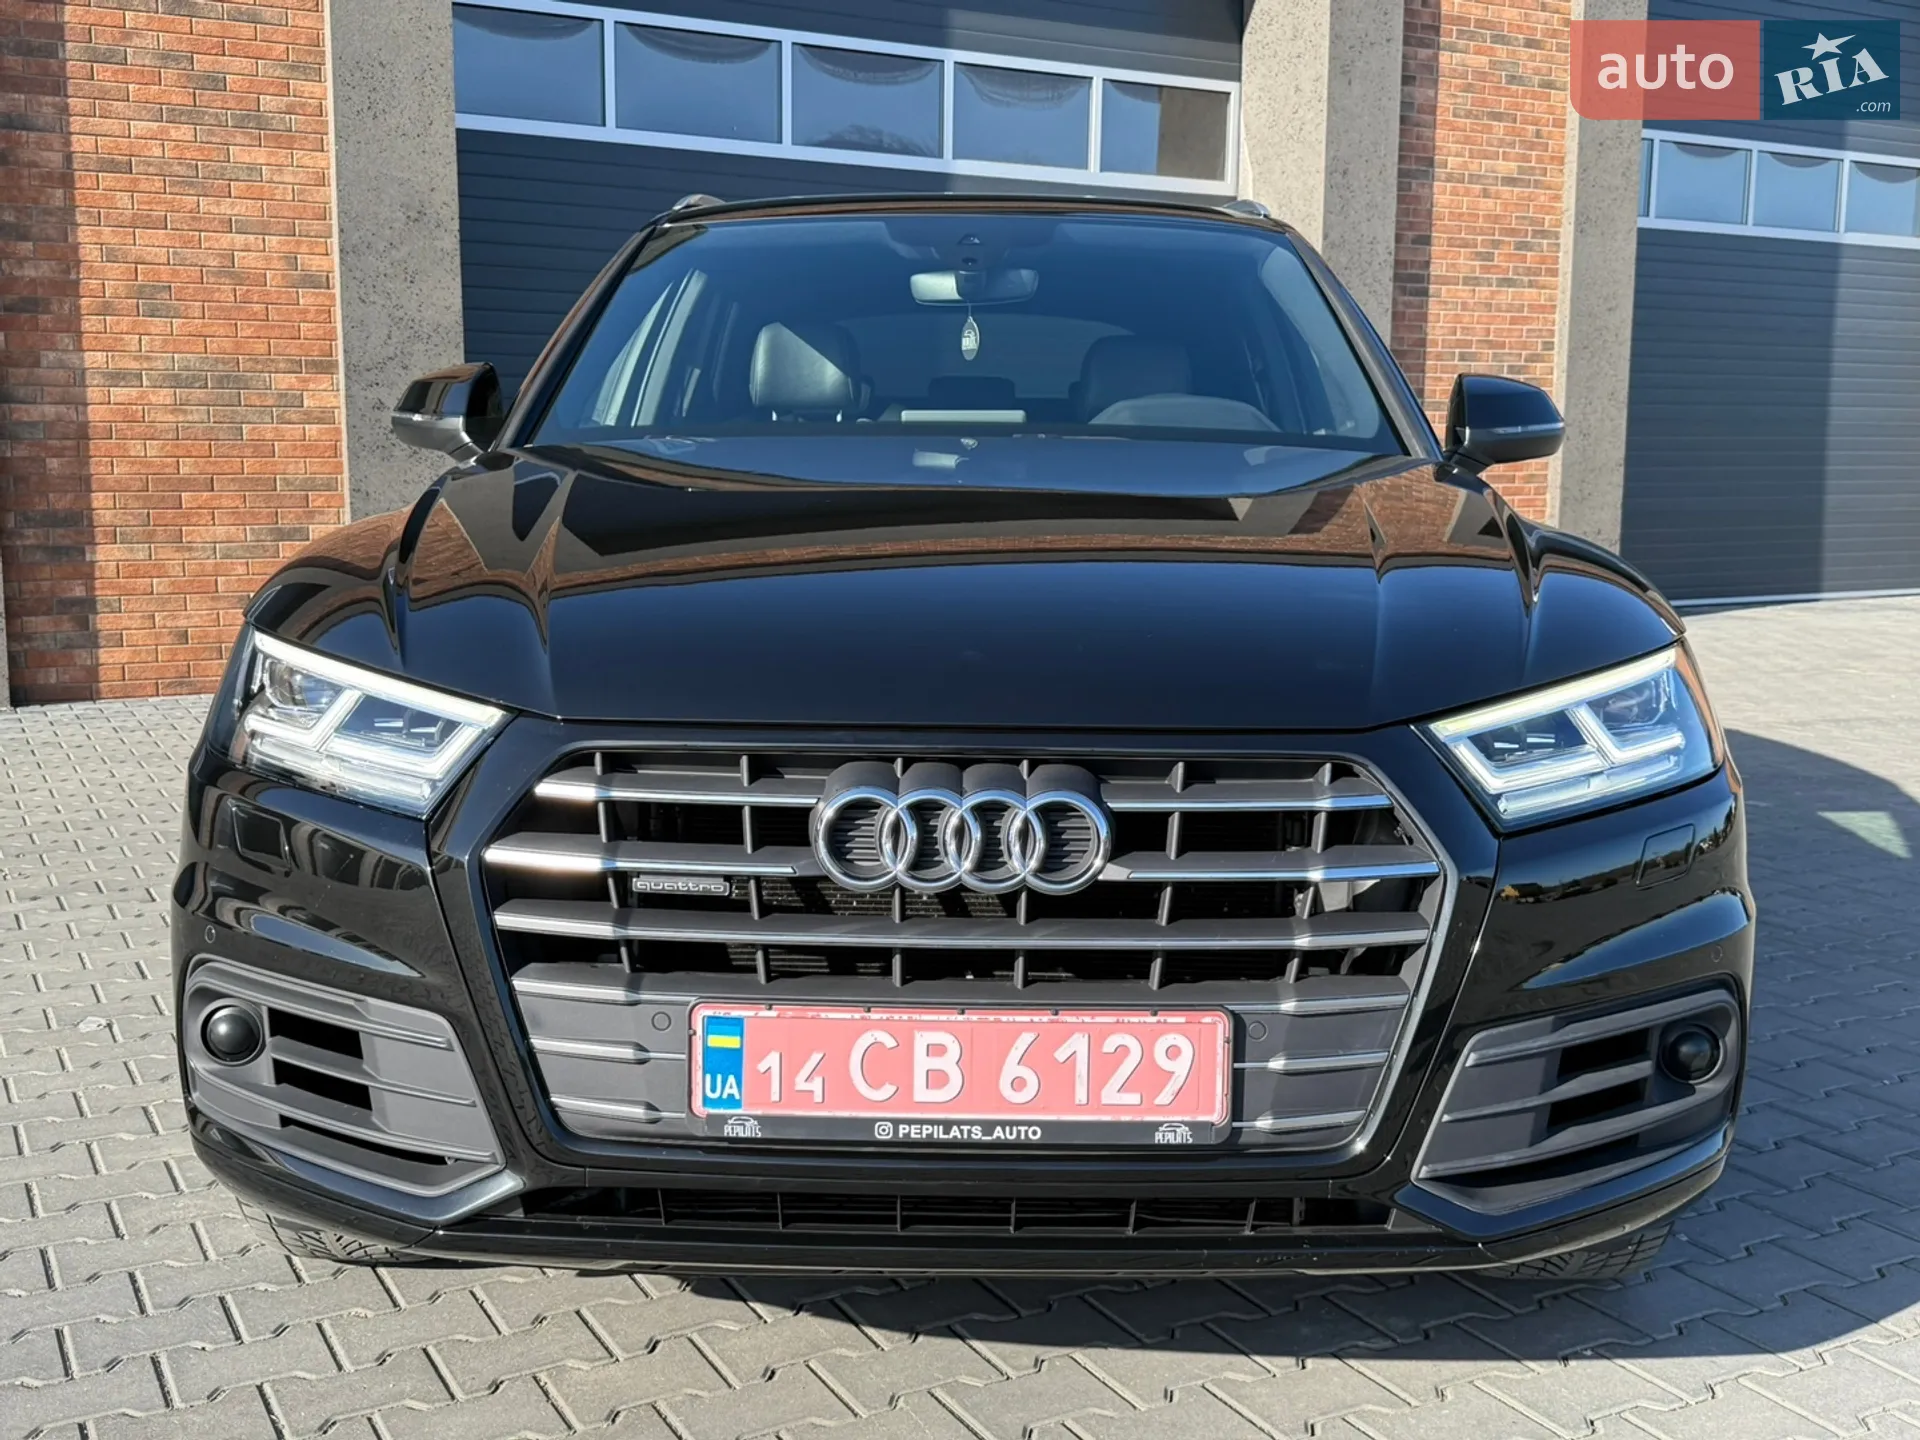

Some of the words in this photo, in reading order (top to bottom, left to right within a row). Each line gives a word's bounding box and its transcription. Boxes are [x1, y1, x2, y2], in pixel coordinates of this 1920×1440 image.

[637, 881, 724, 892] quattro
[756, 1050, 825, 1103] 14
[848, 1029, 965, 1104] CB
[998, 1031, 1196, 1106] 6129
[705, 1073, 740, 1099] UA
[898, 1124, 1042, 1140] PEPILATS_AUTO
